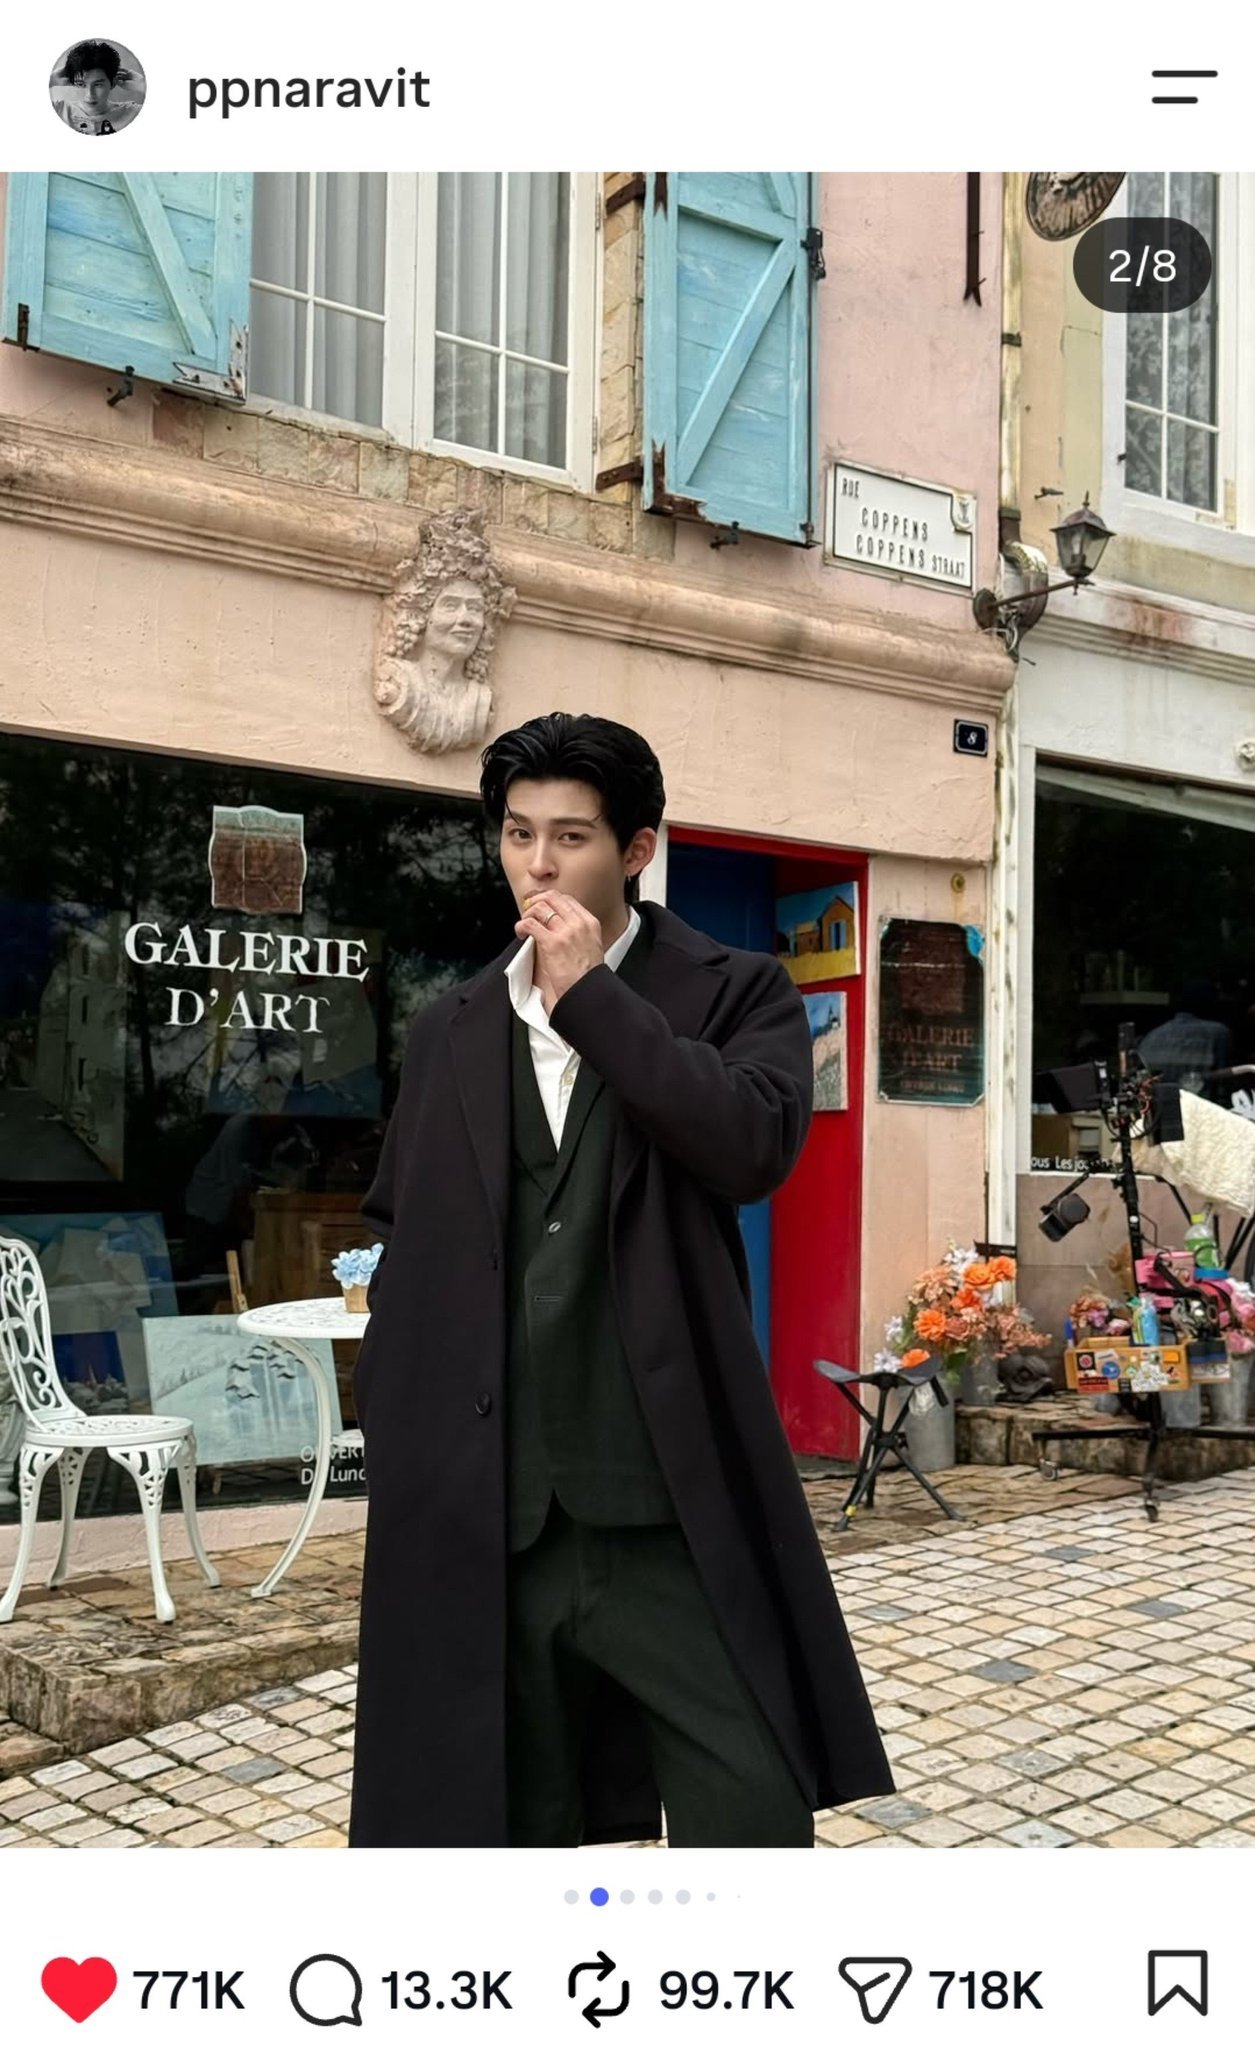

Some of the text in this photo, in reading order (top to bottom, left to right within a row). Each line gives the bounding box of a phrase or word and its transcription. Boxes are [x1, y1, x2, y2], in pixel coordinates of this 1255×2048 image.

[841, 477, 860, 499] RUE
[861, 507, 928, 543] COPPENS
[856, 534, 966, 579] COPPENS STRAAT
[967, 731, 978, 746] 8
[124, 921, 370, 983] GALERIE
